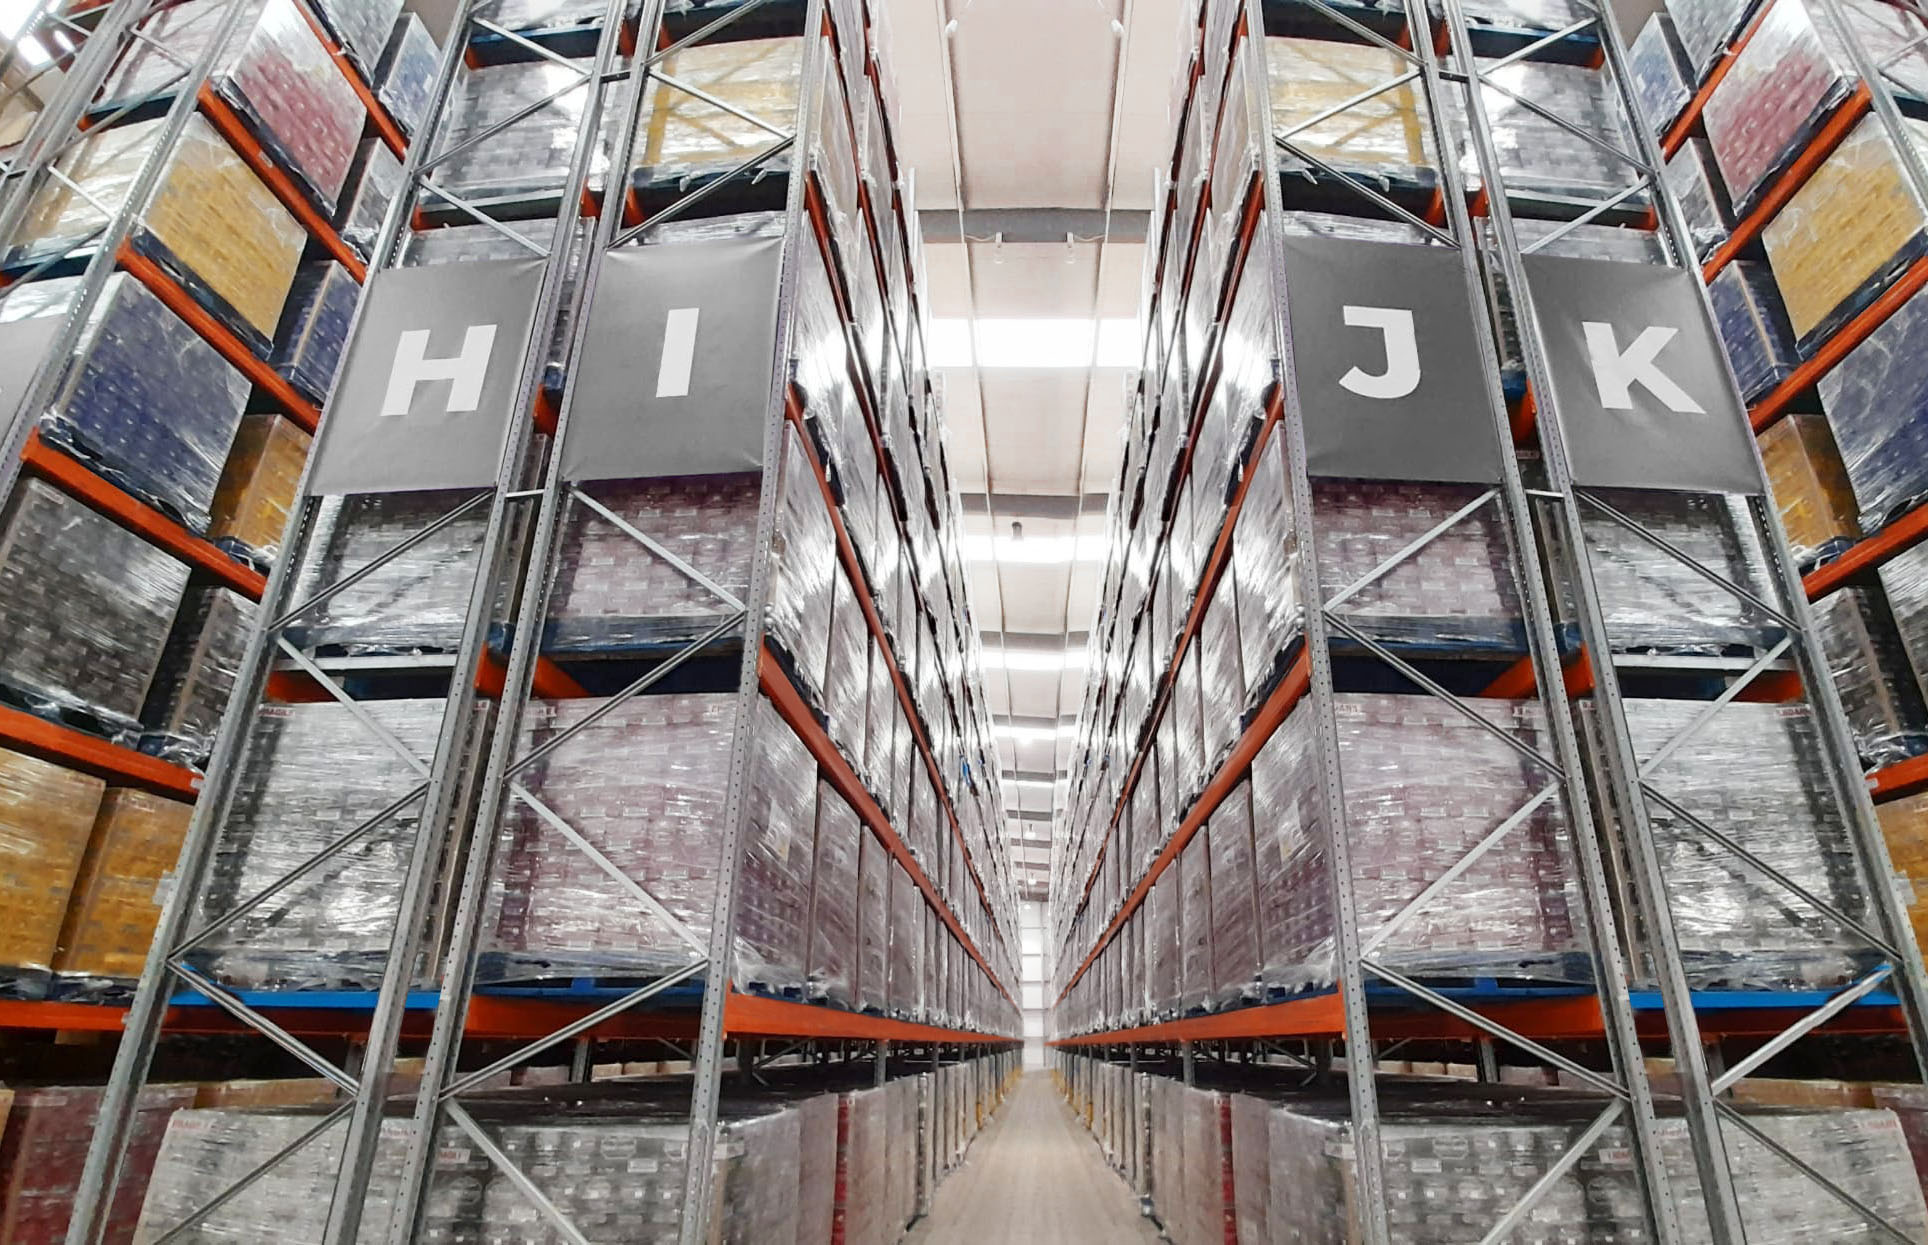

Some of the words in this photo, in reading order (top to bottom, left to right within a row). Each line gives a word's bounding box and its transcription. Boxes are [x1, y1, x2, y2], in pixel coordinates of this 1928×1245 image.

[377, 324, 497, 416] H
[655, 308, 699, 397] I
[1339, 306, 1420, 398] J
[1583, 322, 1706, 414] K
